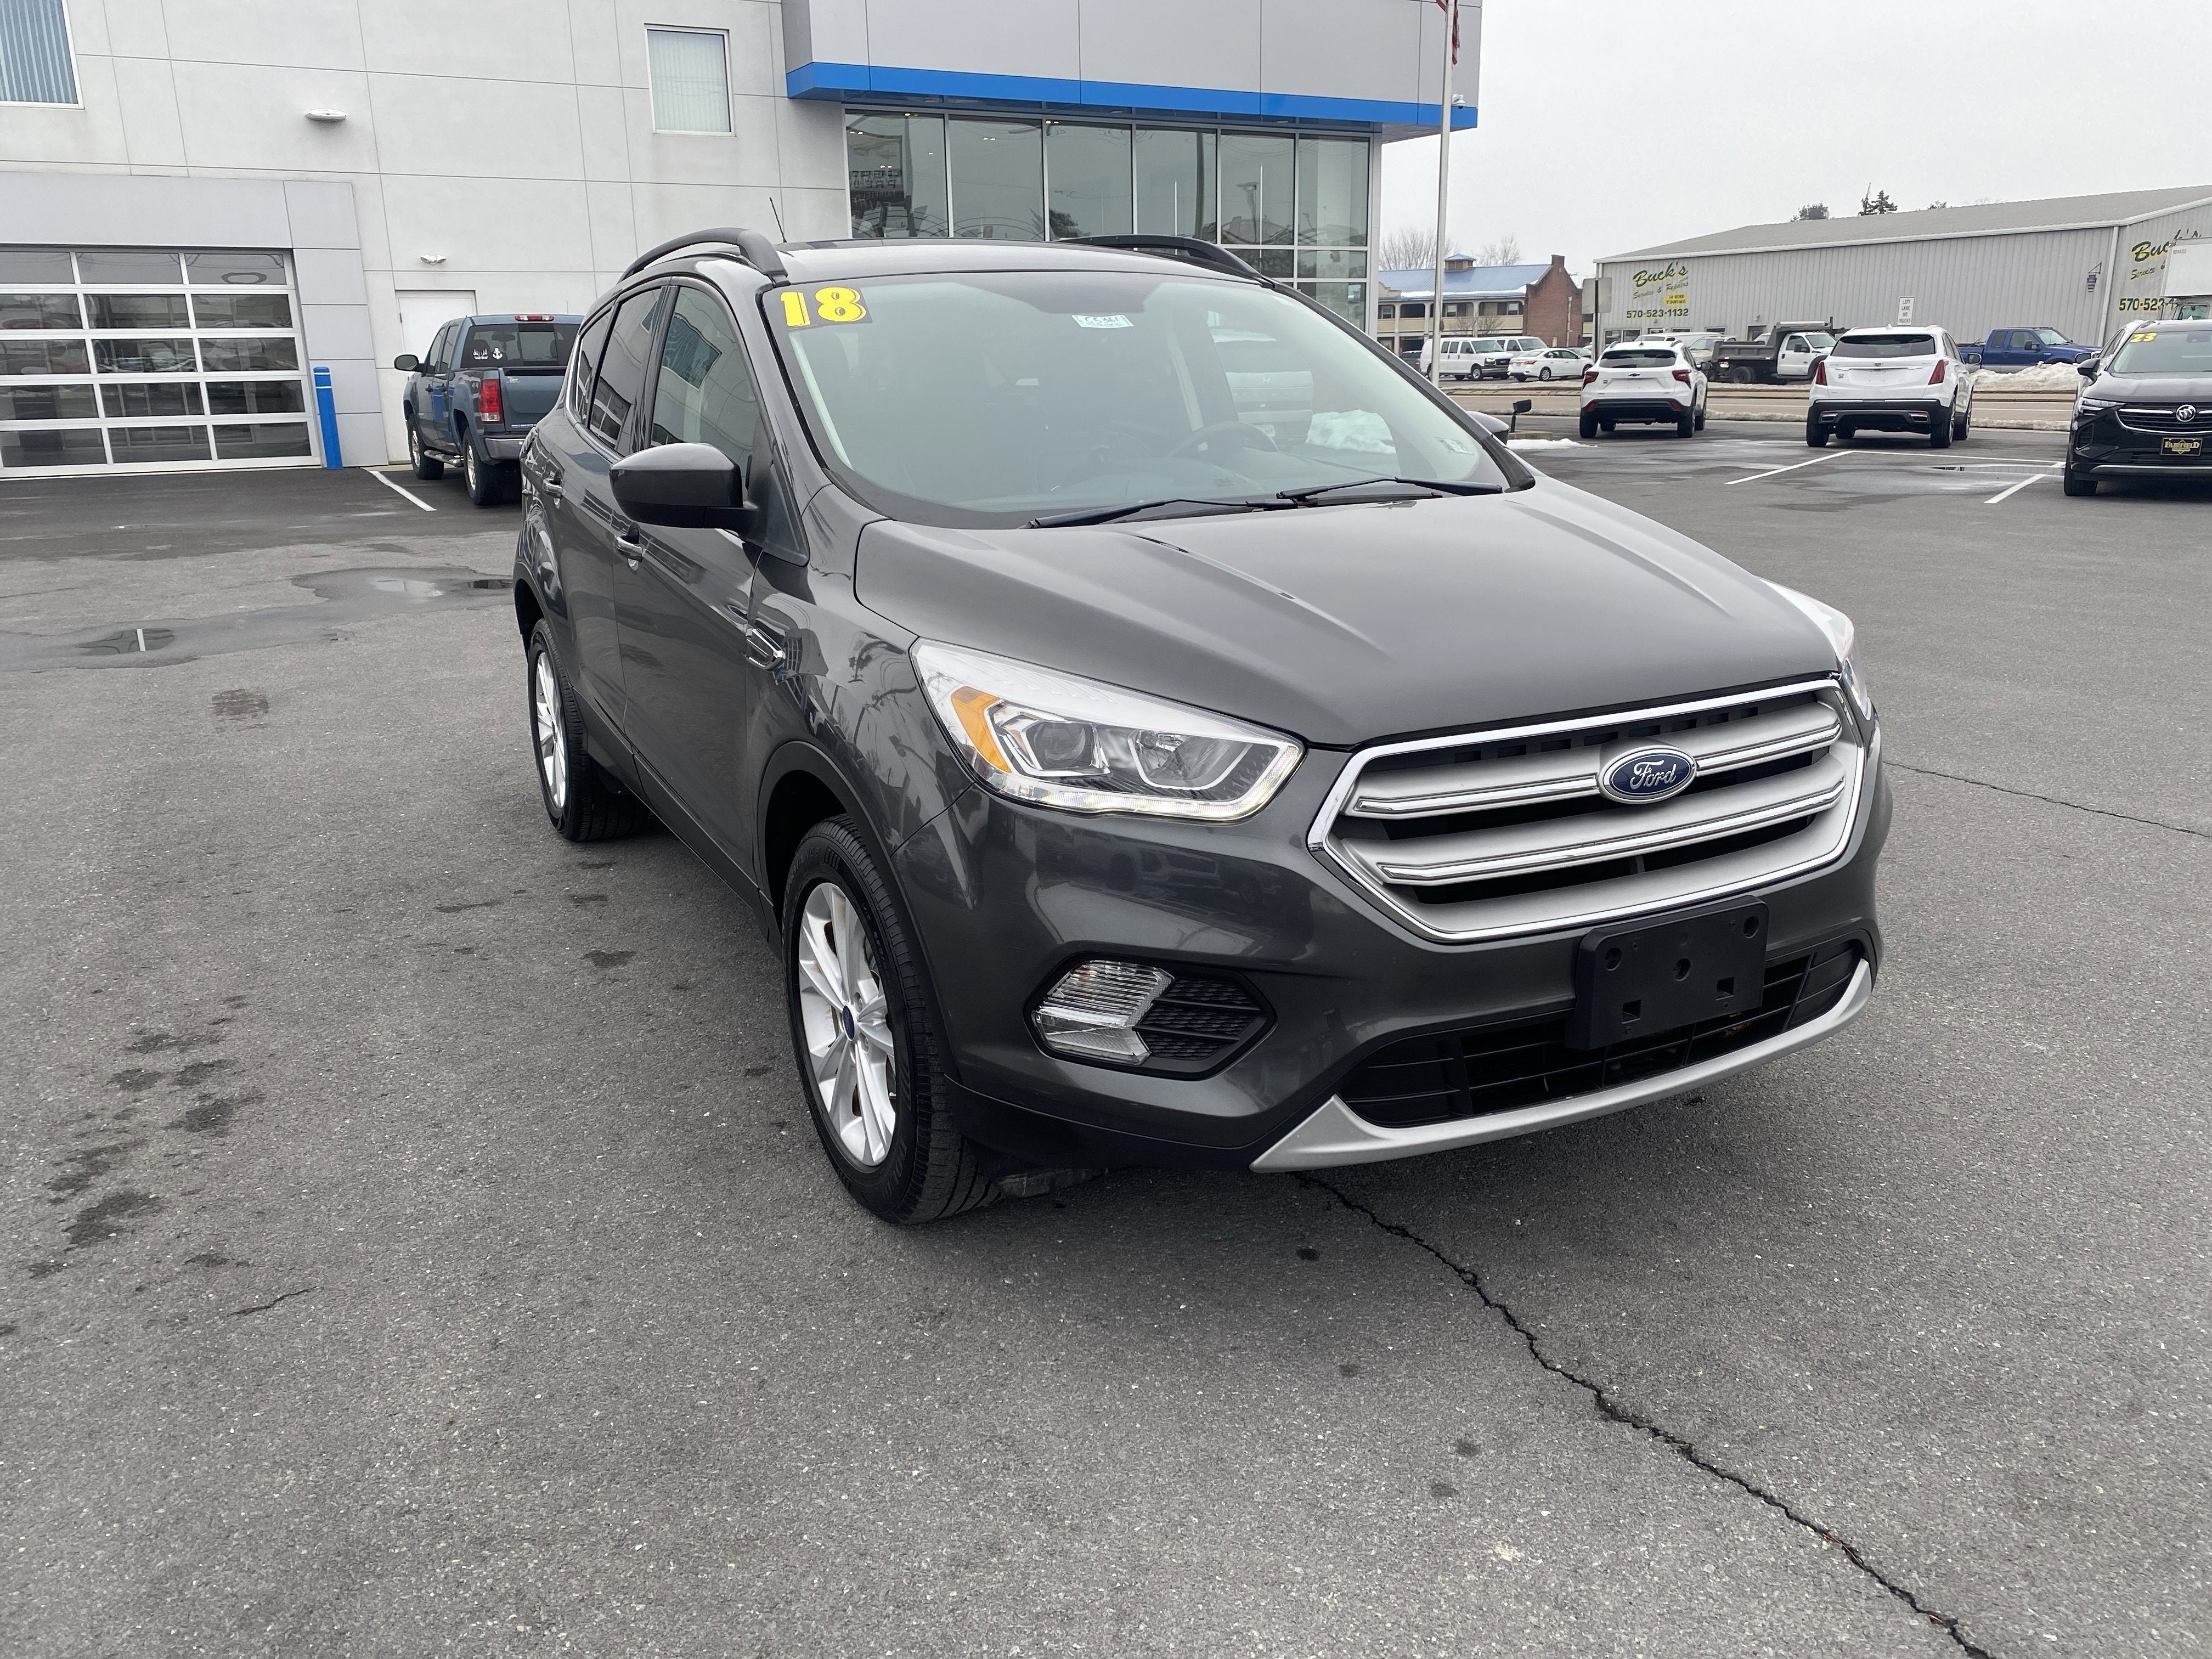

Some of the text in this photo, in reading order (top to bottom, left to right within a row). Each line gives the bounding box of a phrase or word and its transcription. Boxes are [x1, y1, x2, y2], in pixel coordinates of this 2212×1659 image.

[1633, 261, 1689, 287] Buck's
[780, 286, 867, 326] 18
[1626, 308, 1689, 319] 570-523-1132
[2130, 332, 2158, 343] 23
[1629, 759, 1677, 790] Ford
